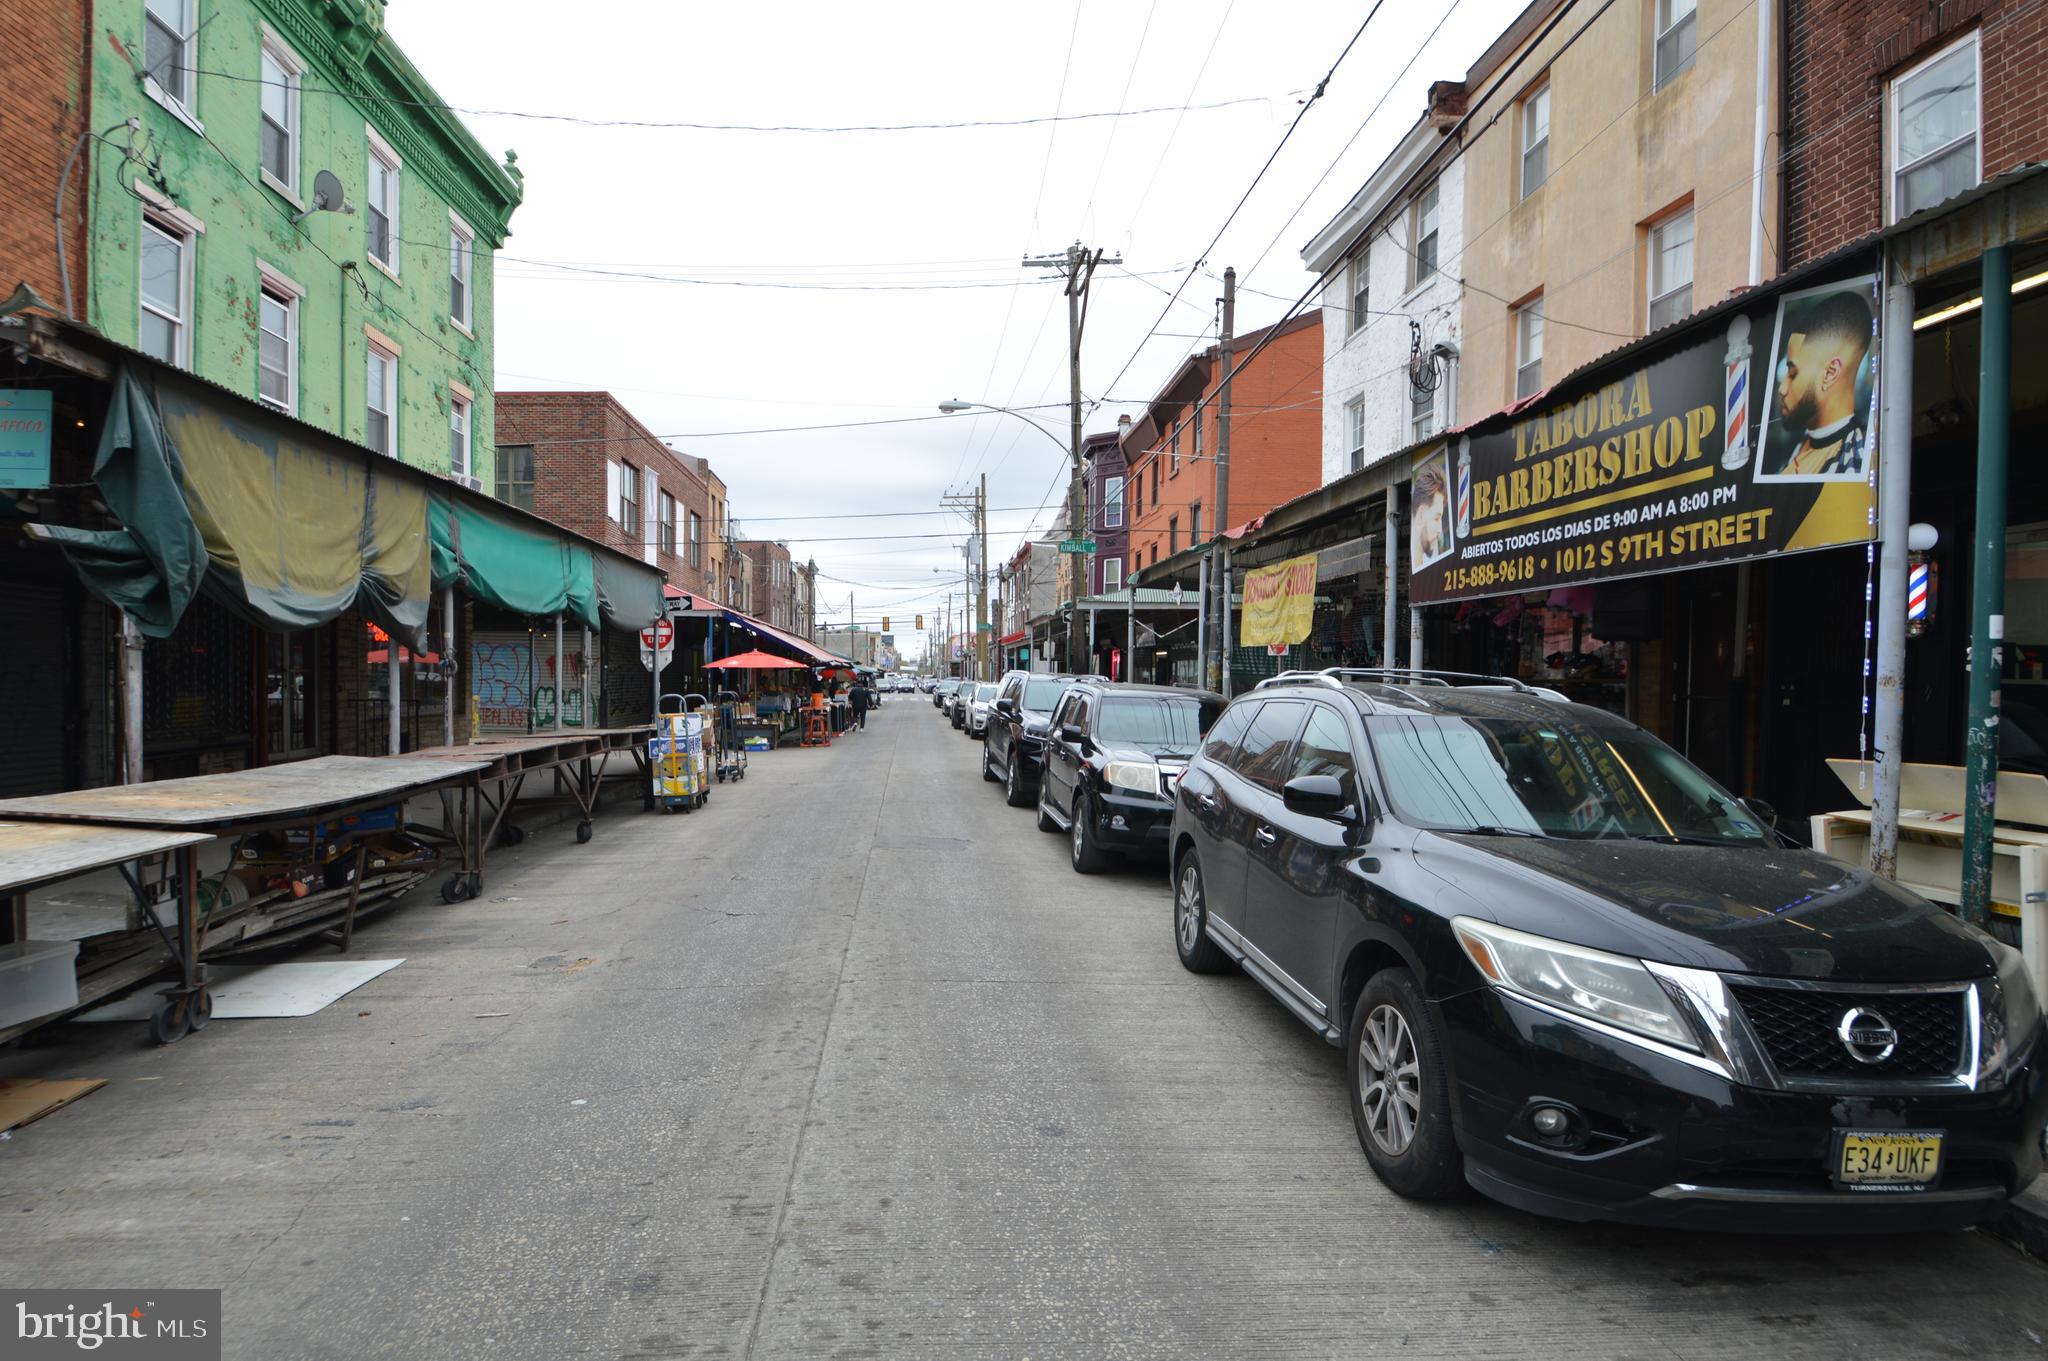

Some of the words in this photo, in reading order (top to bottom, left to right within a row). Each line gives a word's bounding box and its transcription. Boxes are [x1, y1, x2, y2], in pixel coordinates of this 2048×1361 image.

[1512, 369, 1653, 463] TABORA
[1472, 404, 1716, 521] BARBERSHOP
[1060, 543, 1087, 552] KIMBALL
[1443, 555, 1535, 592] 215-888-9618
[1556, 543, 1595, 575] 1012
[1600, 540, 1614, 567] S
[1618, 529, 1664, 564] 9TH
[1670, 507, 1773, 555] STREET
[1461, 539, 1504, 560] ABIERTOS
[1505, 528, 1540, 549] TODOS
[1541, 524, 1562, 543] LOS
[1563, 519, 1591, 538] DIAS
[1594, 515, 1611, 533] DE
[1613, 508, 1637, 528] 9:00
[1640, 502, 1662, 522] AM
[1665, 499, 1677, 516] A
[1679, 491, 1709, 514] 8:00
[1712, 484, 1737, 506] PM
[1849, 1031, 1894, 1043] NISSAN
